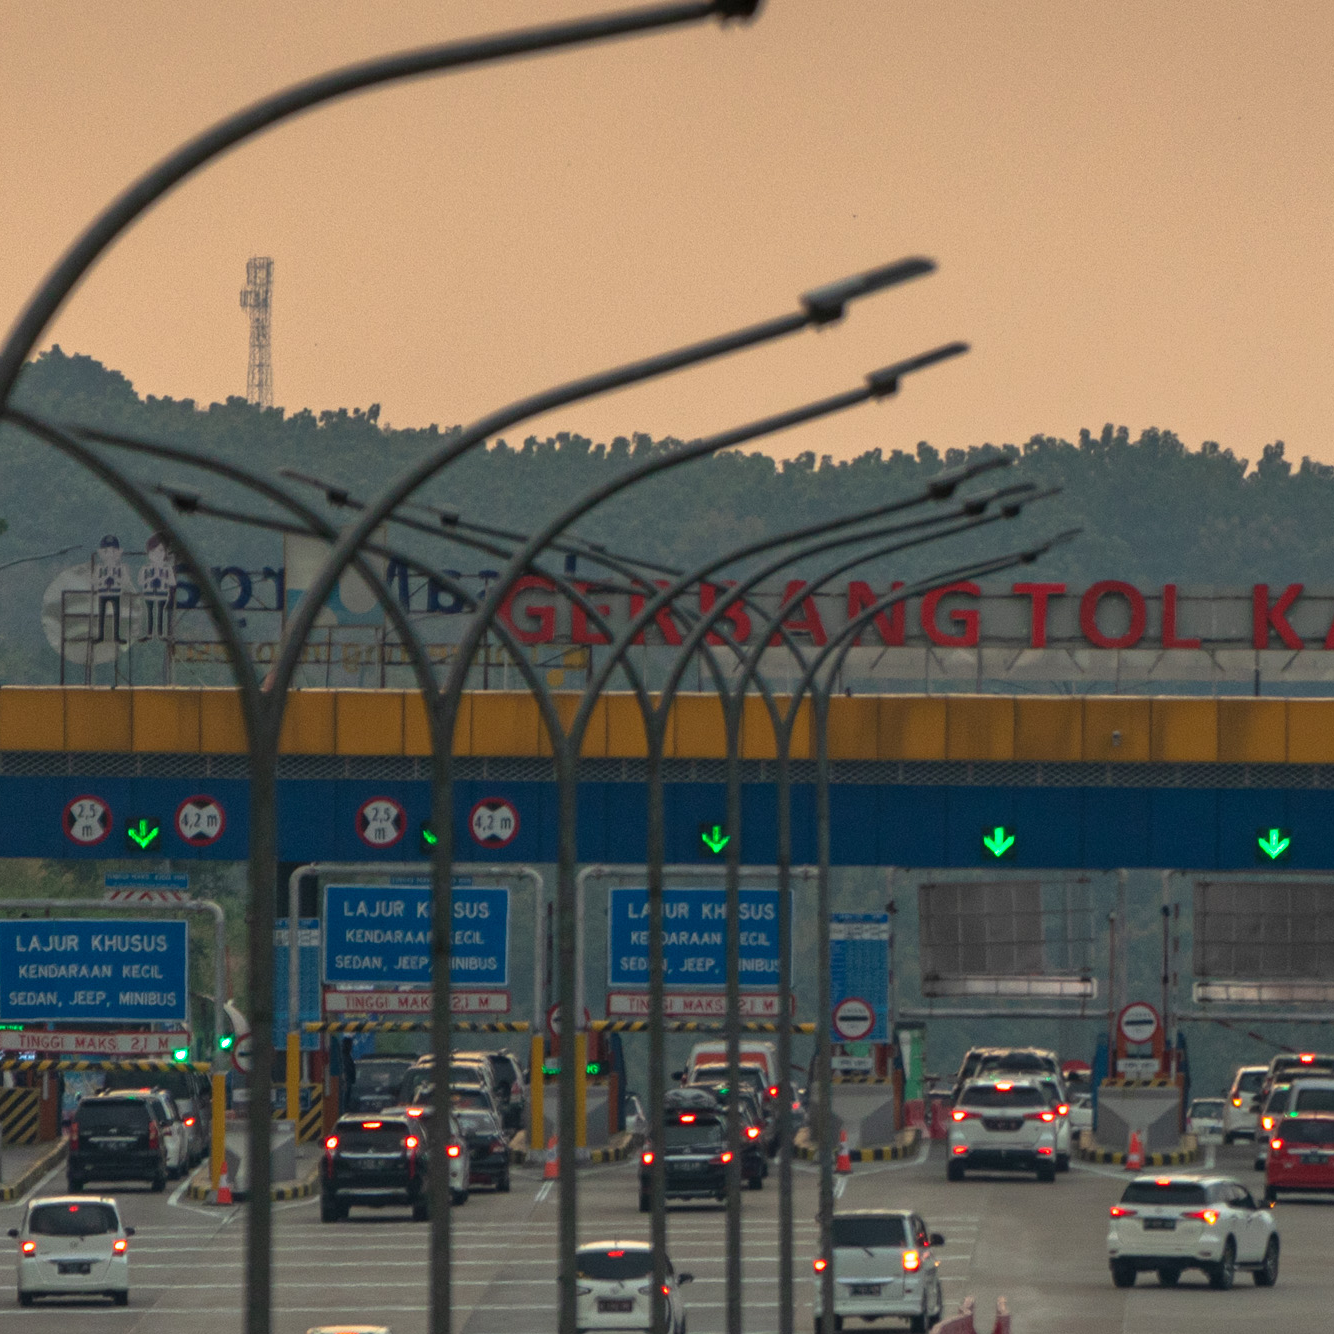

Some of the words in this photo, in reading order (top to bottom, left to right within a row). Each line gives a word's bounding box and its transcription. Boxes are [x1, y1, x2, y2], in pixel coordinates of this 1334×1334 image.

[498, 574, 980, 648] GERBANG
[1012, 580, 1201, 649] TOL
[77, 804, 97, 822] 2,5
[181, 812, 203, 830] 4,2
[206, 813, 218, 827] m
[371, 807, 391, 825] 2,5
[474, 813, 496, 831] 4,2
[499, 814, 512, 829] m
[82, 826, 93, 839] m
[374, 827, 386, 840] m
[344, 901, 405, 917] LAJUR
[417, 902, 490, 918] KSUS
[628, 903, 689, 919] LAUR
[702, 903, 775, 919] KHSUS
[16, 935, 79, 952] LAJUR
[91, 935, 167, 952] KHUSUS
[451, 931, 485, 945] ECIL
[631, 931, 722, 945] KEDARAAN
[739, 932, 770, 946] ECIL
[19, 964, 112, 979] KENDARAAN
[122, 965, 164, 979] KECIL
[335, 955, 388, 972] SEDAN,
[394, 956, 432, 973] JEEP,
[451, 957, 498, 970] INIBUS
[620, 957, 673, 974] SEDN,
[679, 958, 719, 974] JEEP,
[738, 958, 780, 973] INIBUS
[9, 991, 63, 1008] SEDAN,
[69, 991, 111, 1008] JEEP,
[119, 992, 177, 1006] MINIBUS
[345, 995, 389, 1009] TINGGI
[398, 996, 431, 1009] MAK
[479, 997, 490, 1008] M
[628, 999, 673, 1012] TINGI
[763, 1000, 773, 1012] M
[19, 1034, 64, 1049] TINGGI
[158, 1038, 169, 1050] M
